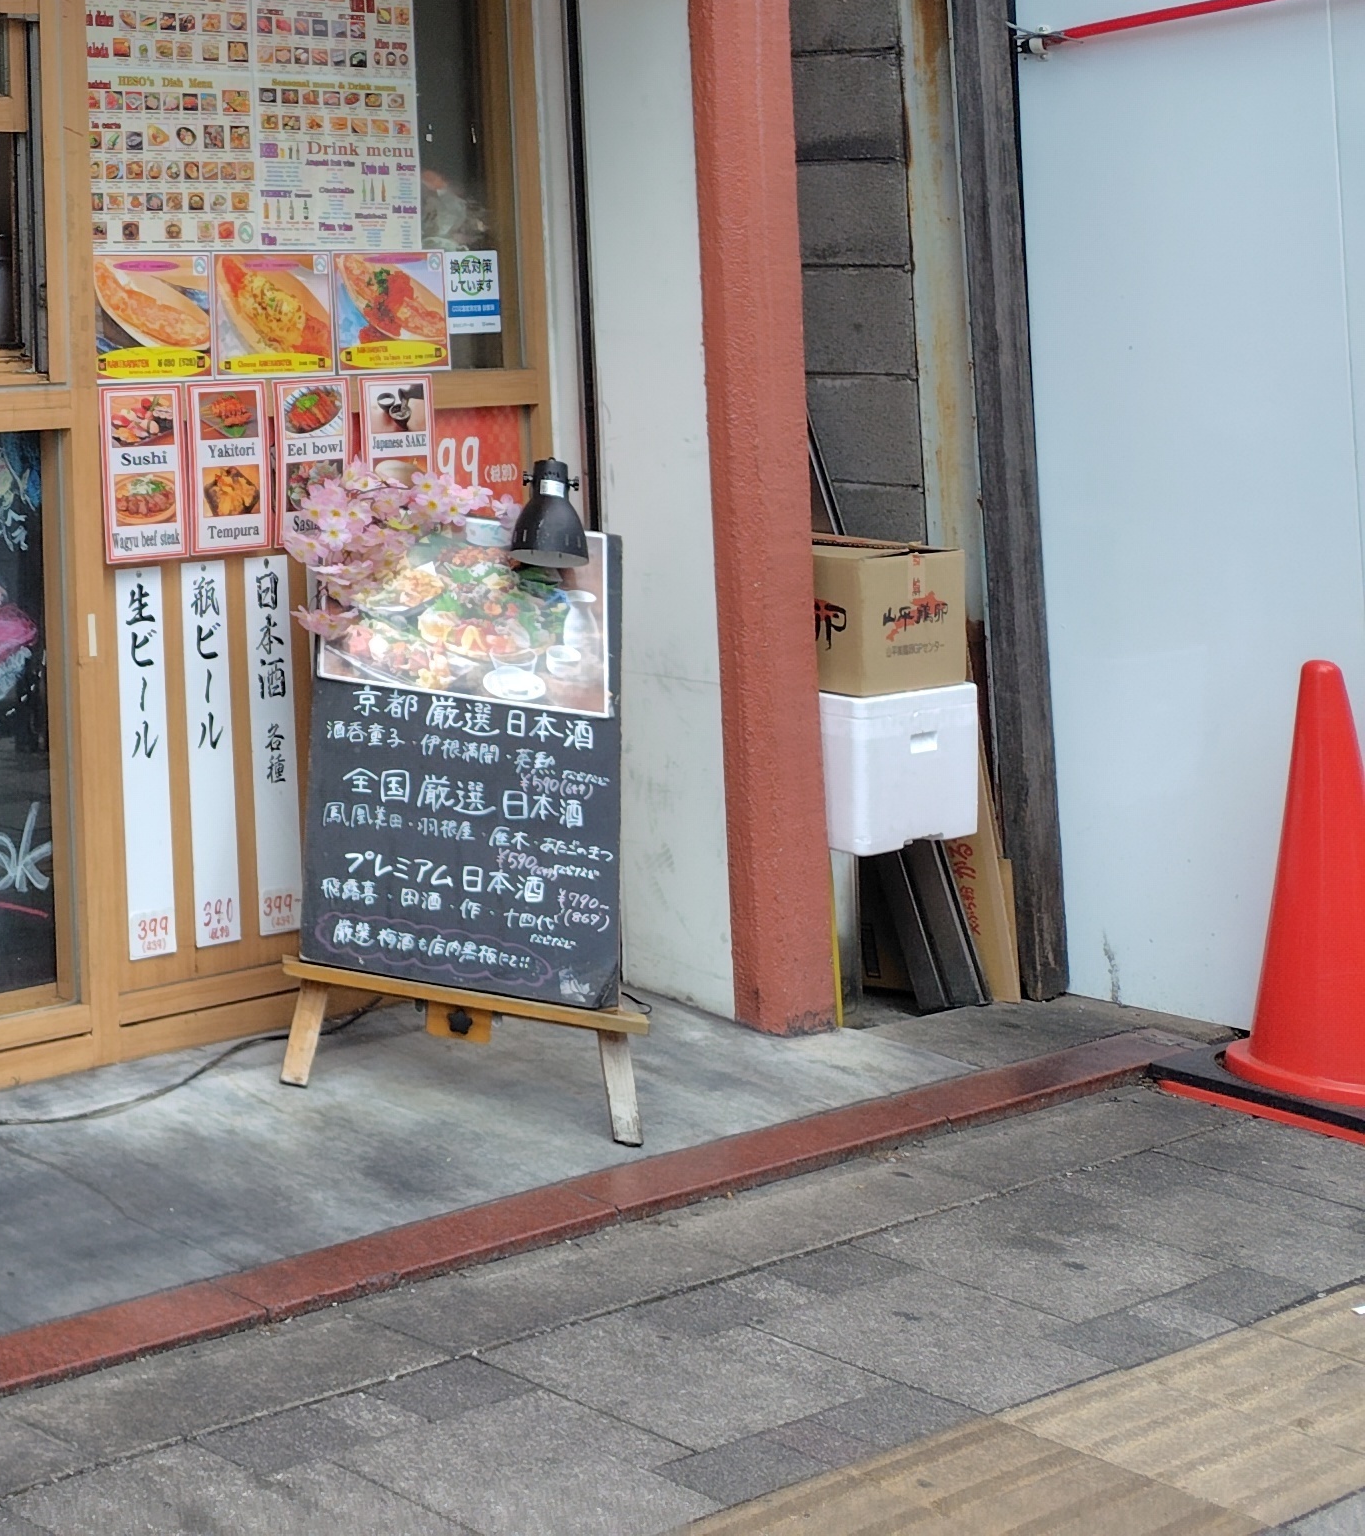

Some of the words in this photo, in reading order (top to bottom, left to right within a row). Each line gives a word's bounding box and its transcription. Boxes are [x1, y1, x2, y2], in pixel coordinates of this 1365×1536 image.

[307, 141, 359, 157] Drink
[366, 146, 414, 158] menu
[450, 259, 493, 275] 換気対策
[450, 279, 494, 293] しています
[207, 442, 256, 458] Yakitori
[287, 443, 307, 456] Eel
[312, 439, 344, 455] bowl
[372, 436, 403, 451] Japanese
[405, 434, 427, 448] SAKE
[120, 450, 168, 466] Sushi
[141, 530, 158, 547] beef
[160, 529, 180, 545] steak
[207, 525, 260, 540] Tempura
[256, 570, 287, 700] 日本酒
[126, 583, 158, 759] 生ビール
[190, 577, 224, 751] 瓶ビール
[264, 723, 287, 784] 各種
[137, 916, 169, 941] 399
